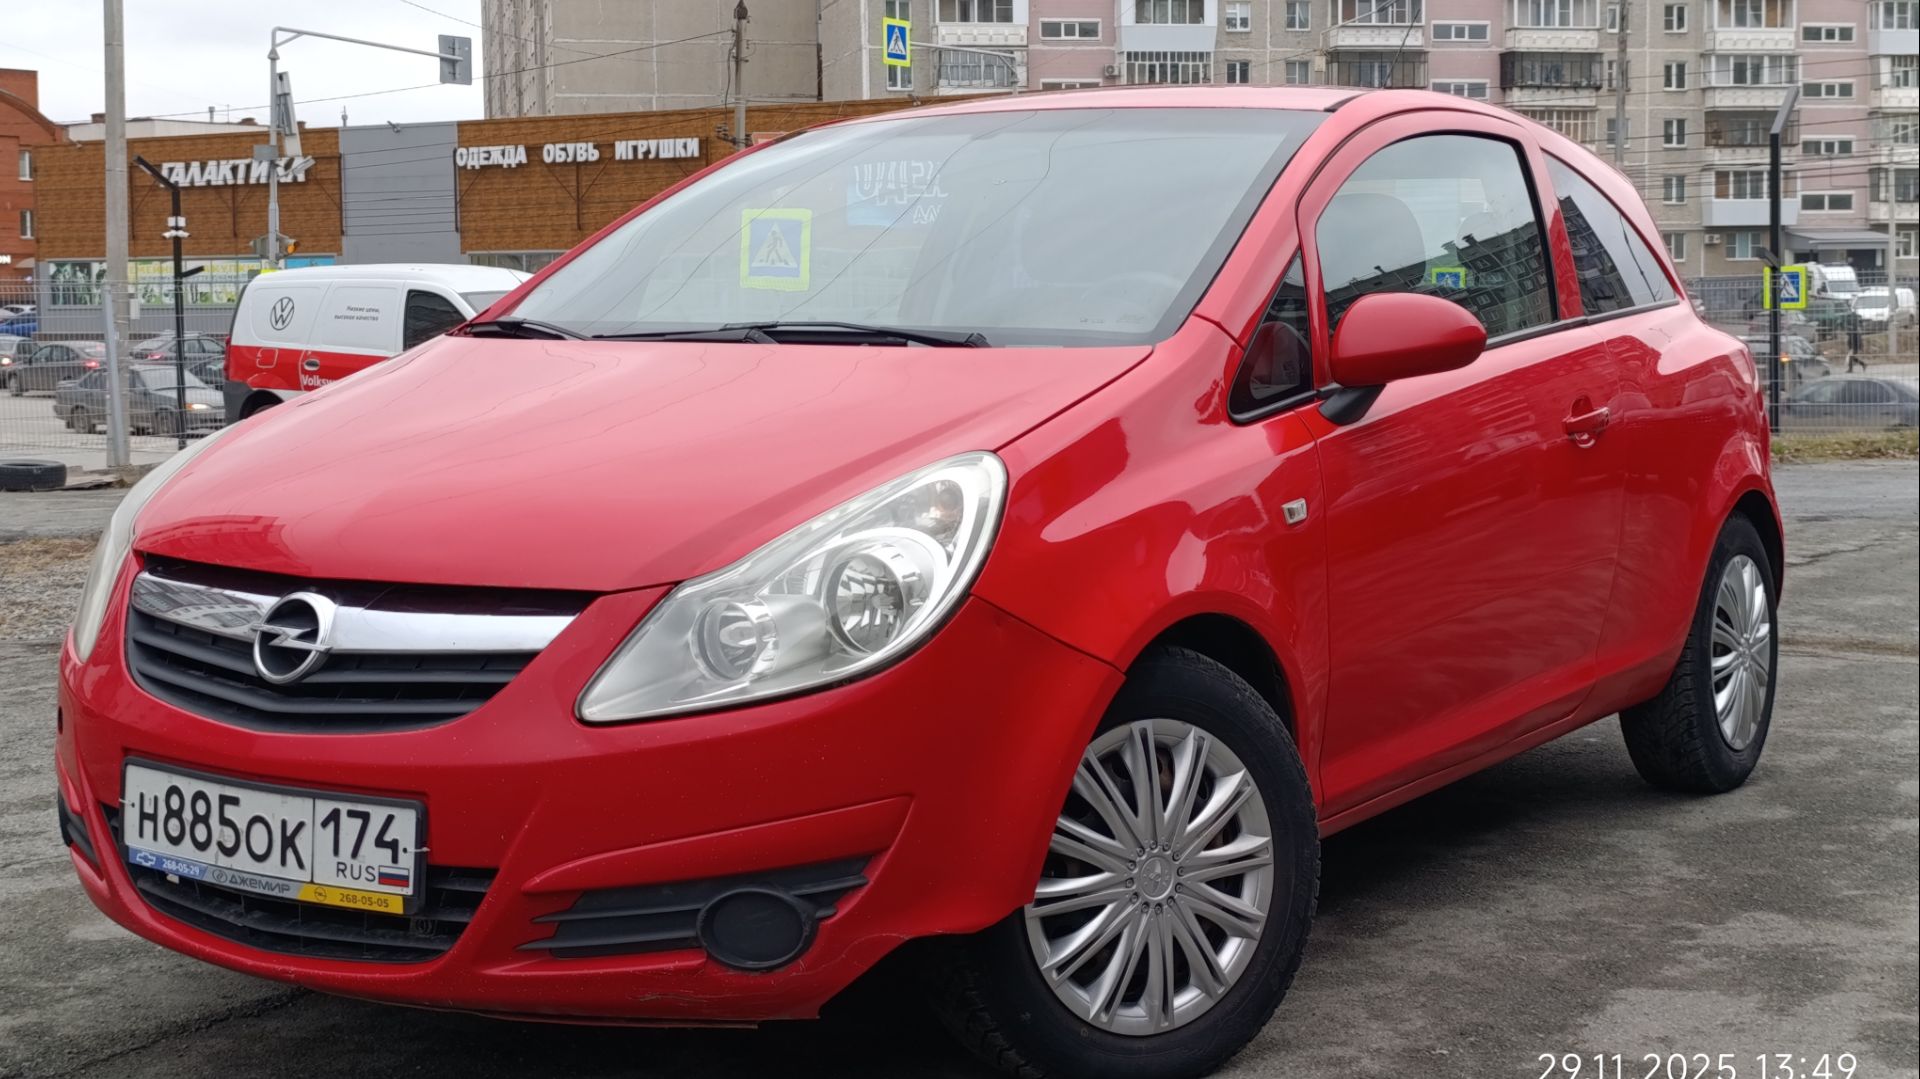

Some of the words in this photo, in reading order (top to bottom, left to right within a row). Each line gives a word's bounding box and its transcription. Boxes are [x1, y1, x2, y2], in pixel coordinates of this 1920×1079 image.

[456, 145, 527, 169] ОДЕЖДА
[543, 142, 600, 163] ОБУВЬ
[614, 137, 700, 161] ИГРУШКИ
[138, 785, 307, 871] Н885ОК
[320, 807, 400, 864] 174
[162, 857, 200, 876] 268-05-29
[336, 862, 376, 882] RUS
[339, 892, 390, 908] 268-05-05
